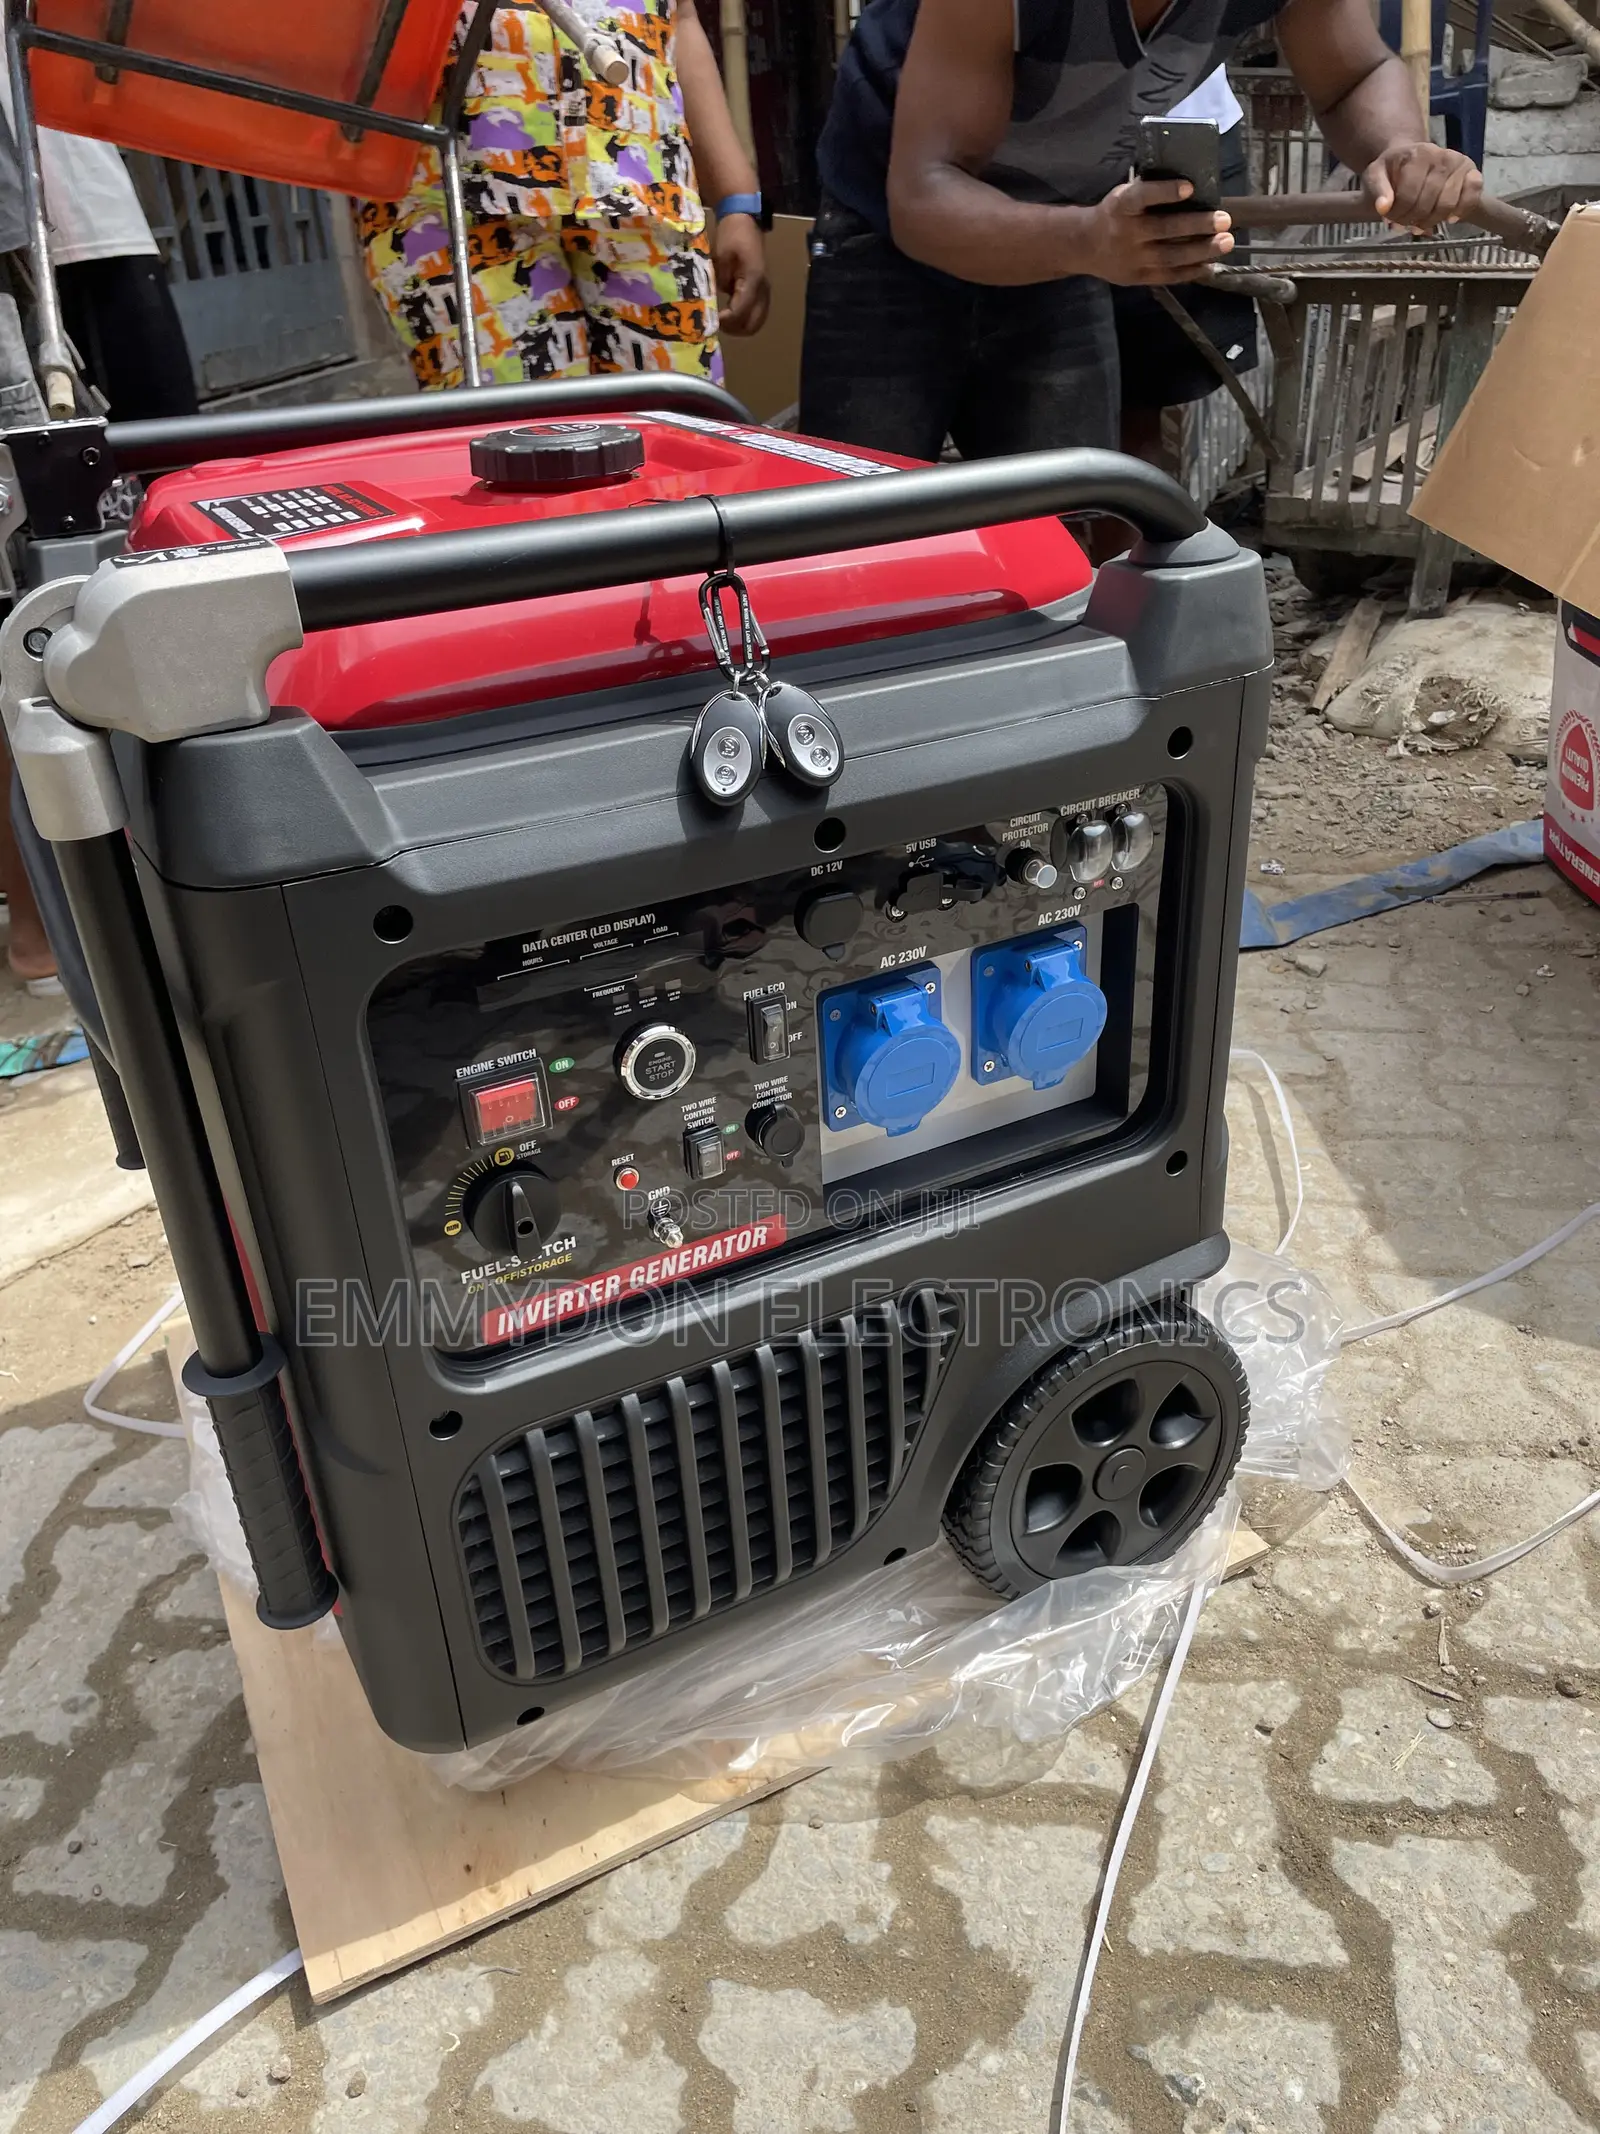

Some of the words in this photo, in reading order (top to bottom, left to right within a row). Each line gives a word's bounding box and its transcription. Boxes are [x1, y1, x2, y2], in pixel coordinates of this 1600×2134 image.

[1060, 798, 1097, 817] CIRCUIT
[1098, 788, 1140, 807] BREAKER
[1010, 812, 1042, 828] CIRCUIT
[1002, 822, 1049, 842] PROTECTOR
[905, 842, 918, 854] 5V
[919, 837, 938, 850] USB
[1020, 839, 1032, 849] 9A
[1549, 828, 1600, 887] ENERATOR
[810, 866, 824, 877] DC
[826, 860, 843, 872] 12V
[1038, 913, 1053, 926] AC
[1054, 904, 1082, 921] 230V
[522, 940, 549, 954] DATA
[550, 930, 588, 947] CENTER
[590, 923, 612, 938] (LED
[613, 913, 656, 933] DISPLAY)
[653, 925, 668, 935] LOAD
[593, 938, 619, 949] VOLTAGE
[522, 957, 543, 966] HOURS
[880, 956, 896, 969] AC
[899, 946, 928, 964] 230V
[592, 985, 625, 998] FREQUENCY
[743, 988, 766, 1001] FUEL
[767, 981, 785, 996] ECO
[456, 1059, 496, 1079] ENGINE
[496, 1048, 537, 1068] SWITCH
[555, 1060, 569, 1071] ON
[645, 1061, 676, 1075] START
[648, 1056, 672, 1066] ENGINE
[648, 1069, 675, 1082] STOP
[754, 1081, 770, 1092] TWO
[770, 1075, 789, 1087] WIRE
[756, 1085, 788, 1100] CONTROL
[558, 1097, 576, 1110] OFF
[681, 1102, 697, 1113] TWO
[698, 1096, 717, 1108] WIRE
[752, 1092, 793, 1110] CONNECTOR
[683, 1107, 716, 1122] CONTROL
[687, 1116, 714, 1130] SWITCH
[725, 1124, 736, 1132] ON
[519, 1139, 537, 1153] OFF
[516, 1148, 542, 1160] STORAGE
[611, 1153, 635, 1167] RESET
[726, 1151, 739, 1160] OFF
[648, 1186, 671, 1201] GND
[460, 1236, 577, 1285] FUEL-STCH
[468, 1283, 485, 1294] ON
[495, 1253, 573, 1285] OFF/STORAGE
[497, 1275, 620, 1336] INVERTER
[630, 1225, 768, 1290] GENERATOR
